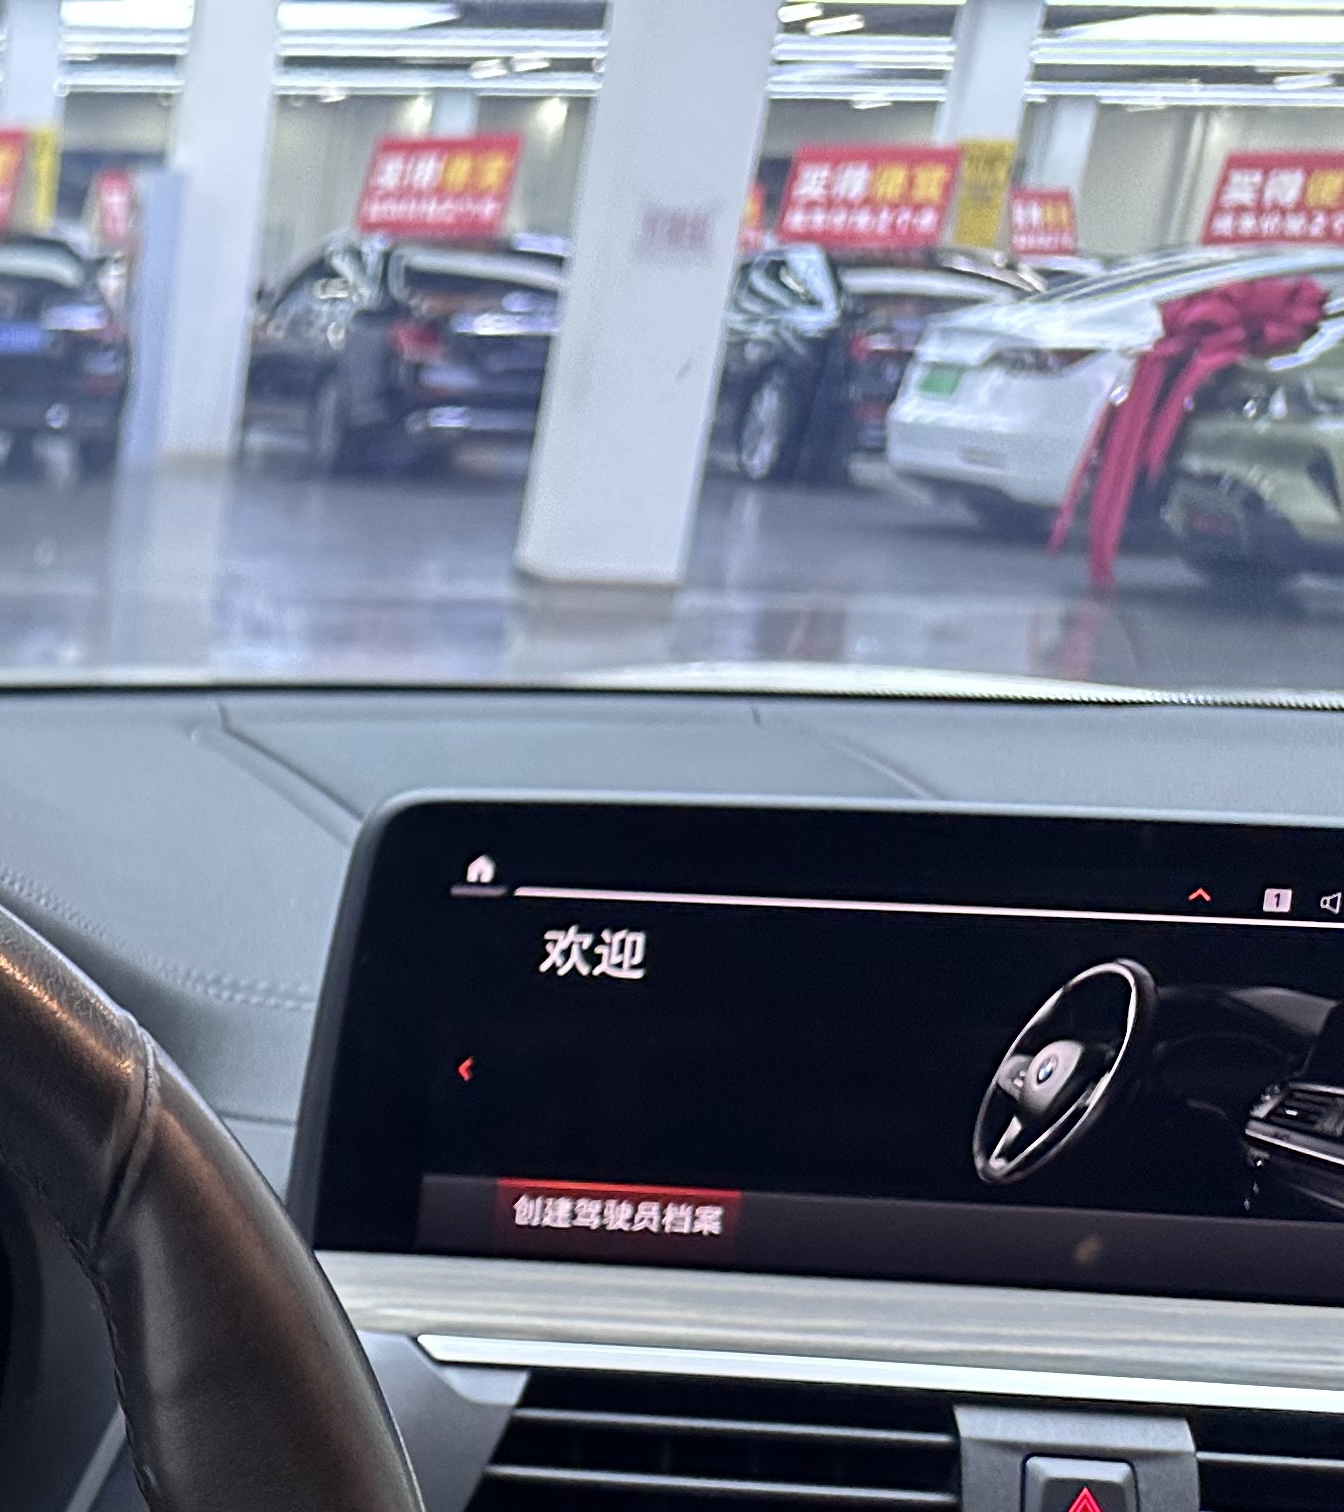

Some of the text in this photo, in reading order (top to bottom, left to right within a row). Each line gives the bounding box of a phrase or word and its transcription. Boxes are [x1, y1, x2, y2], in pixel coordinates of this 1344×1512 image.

[538, 923, 647, 980] 欢迎
[513, 1194, 725, 1237] 创建驾驶员档案
